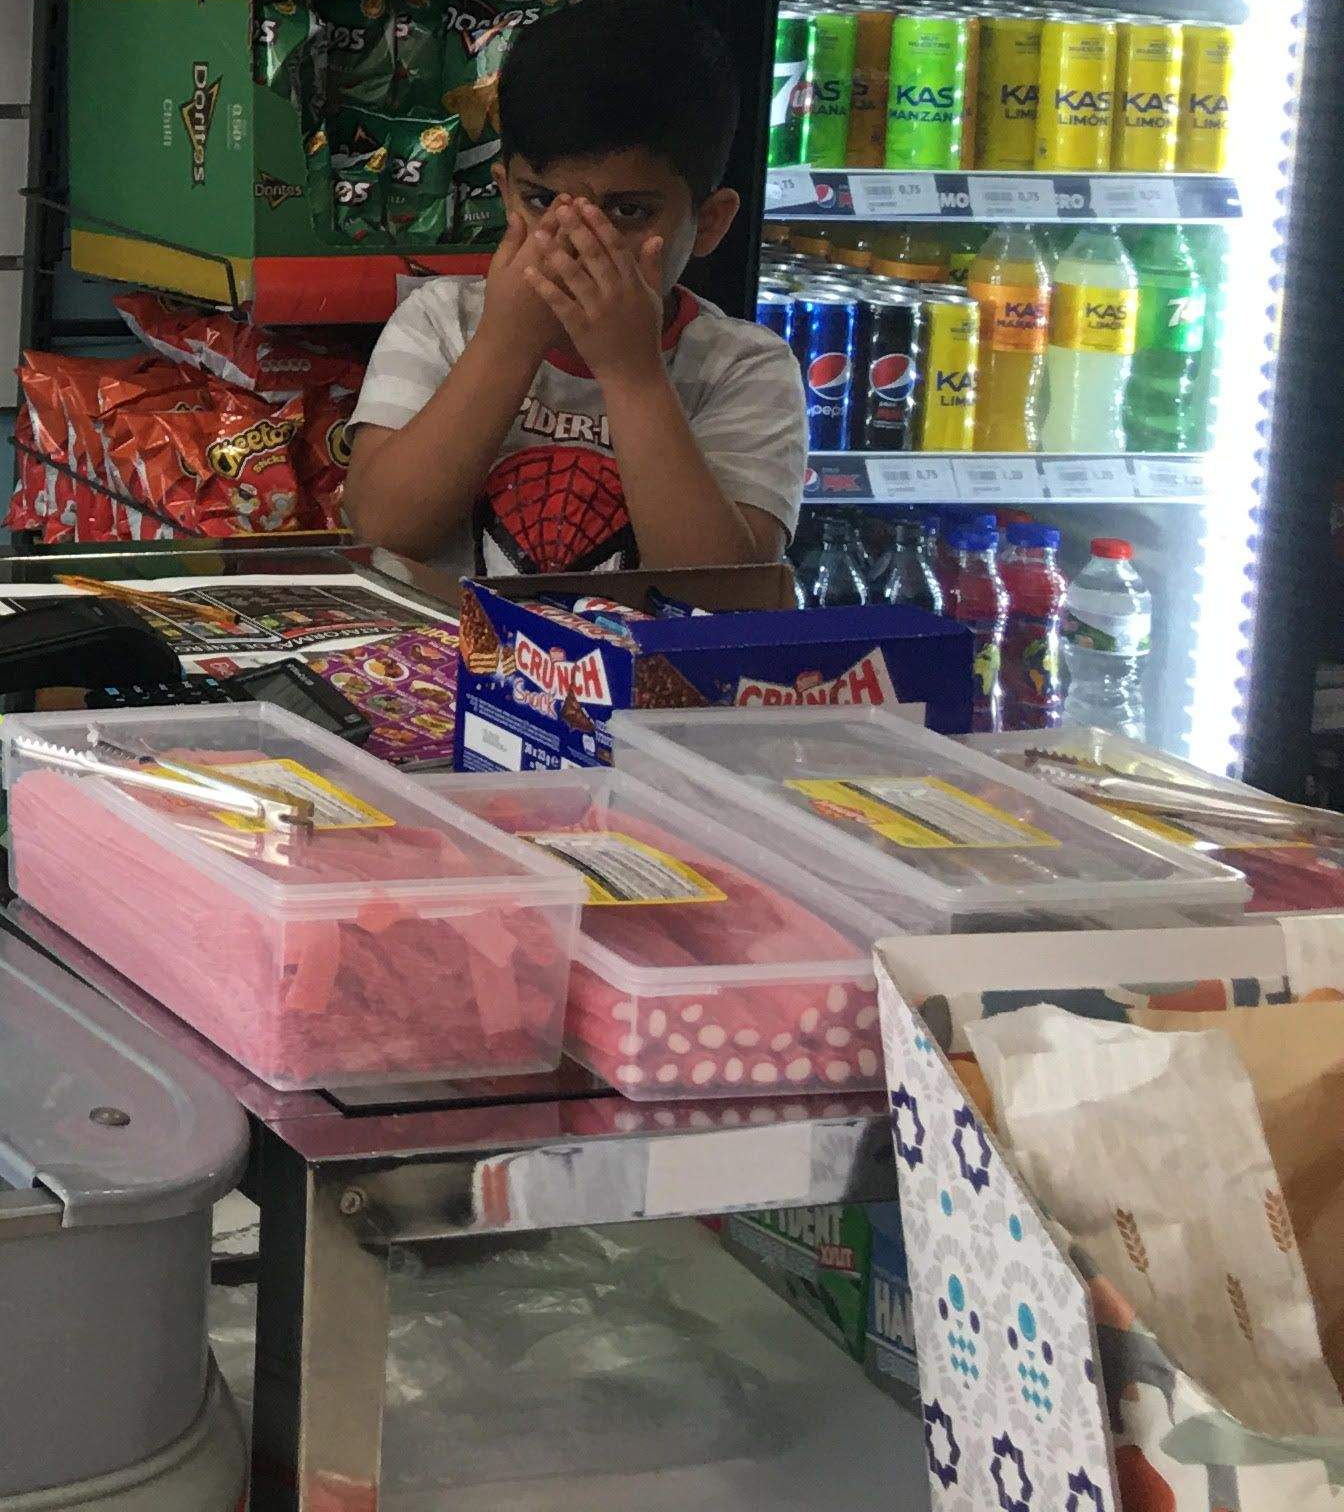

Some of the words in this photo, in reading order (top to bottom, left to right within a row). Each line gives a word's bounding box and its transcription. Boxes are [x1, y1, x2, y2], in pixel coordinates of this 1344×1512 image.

[895, 83, 955, 108] KAS
[1054, 88, 1111, 112] KAS
[192, 64, 207, 183] Doritos
[254, 183, 303, 199] Doritos
[1084, 301, 1127, 321] KAS
[516, 639, 604, 700] CRUNCH
[514, 677, 558, 719] Snack
